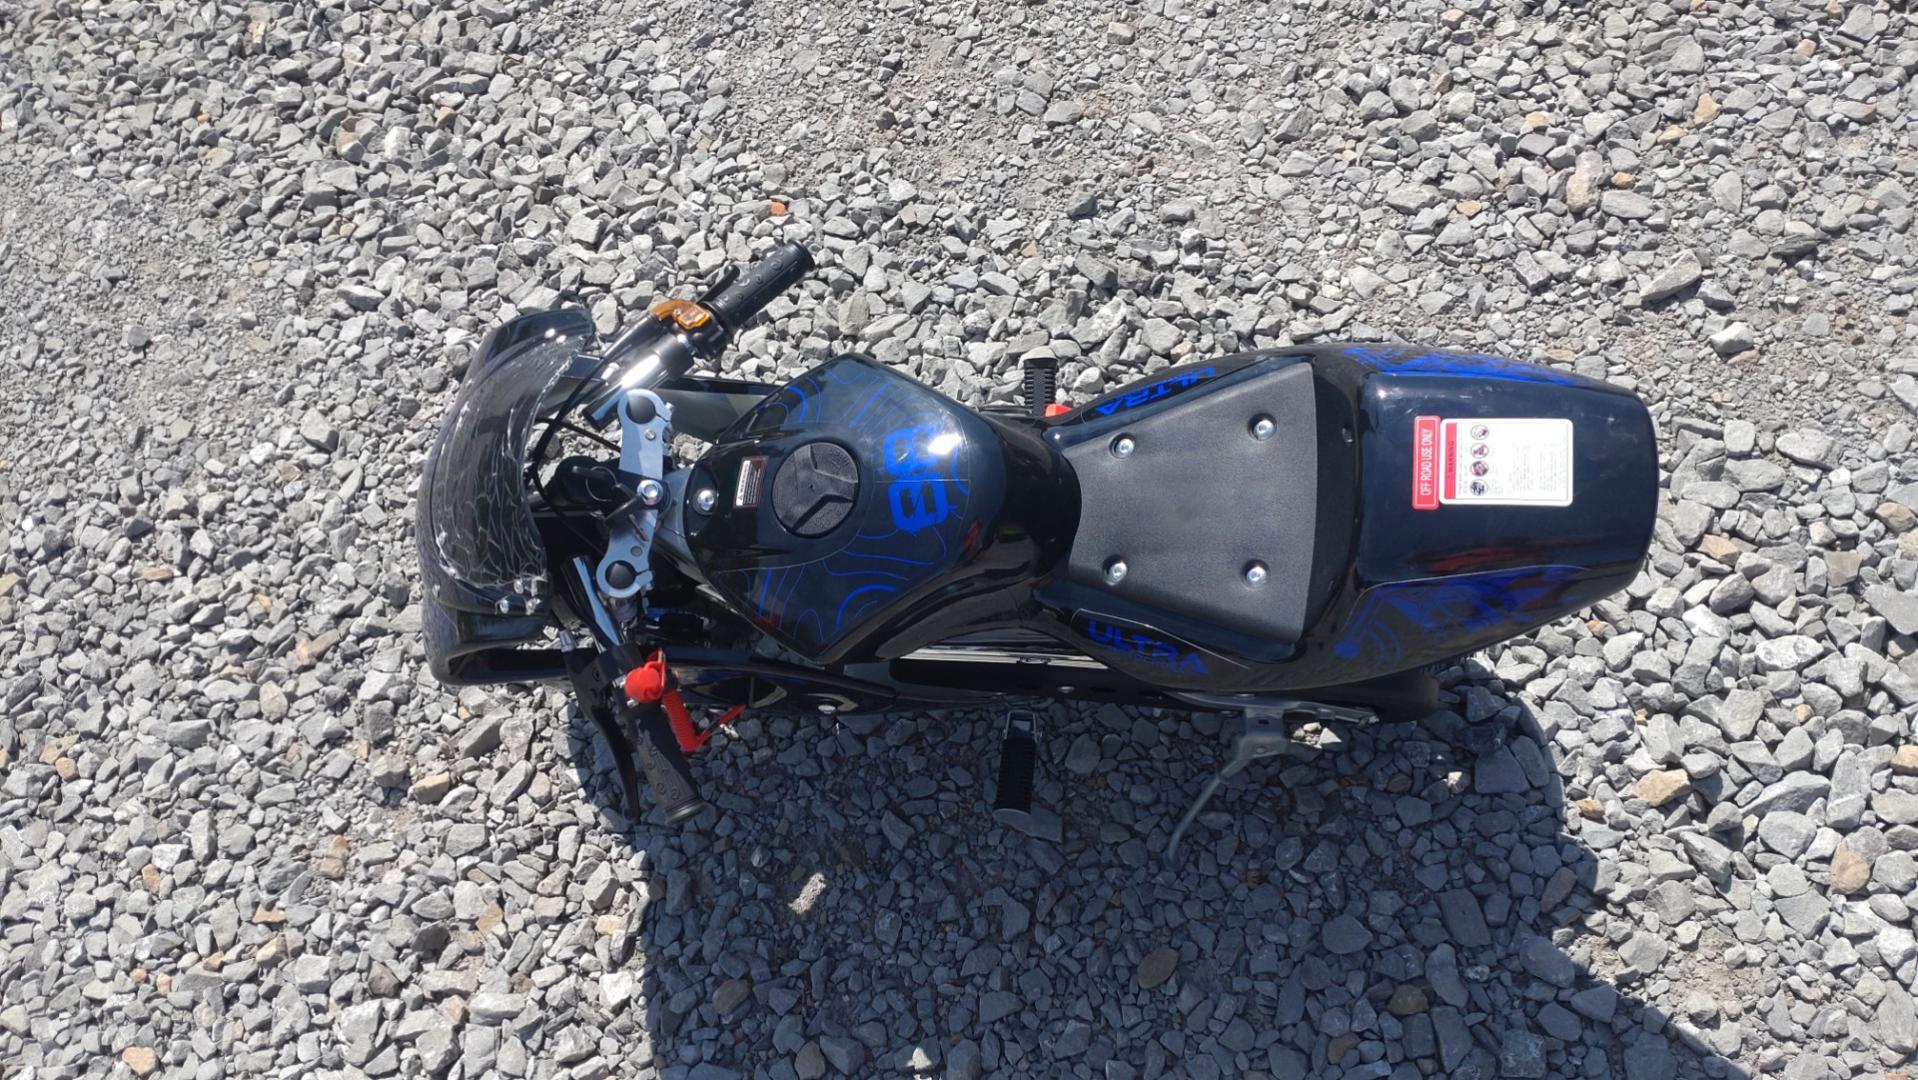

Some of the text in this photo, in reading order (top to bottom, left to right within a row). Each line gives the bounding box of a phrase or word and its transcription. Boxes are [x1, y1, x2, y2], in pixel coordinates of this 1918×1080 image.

[1095, 367, 1216, 416] ULTRA
[1420, 428, 1433, 496] OFF ROAD USE ONLY
[1088, 617, 1208, 674] ULTRA
